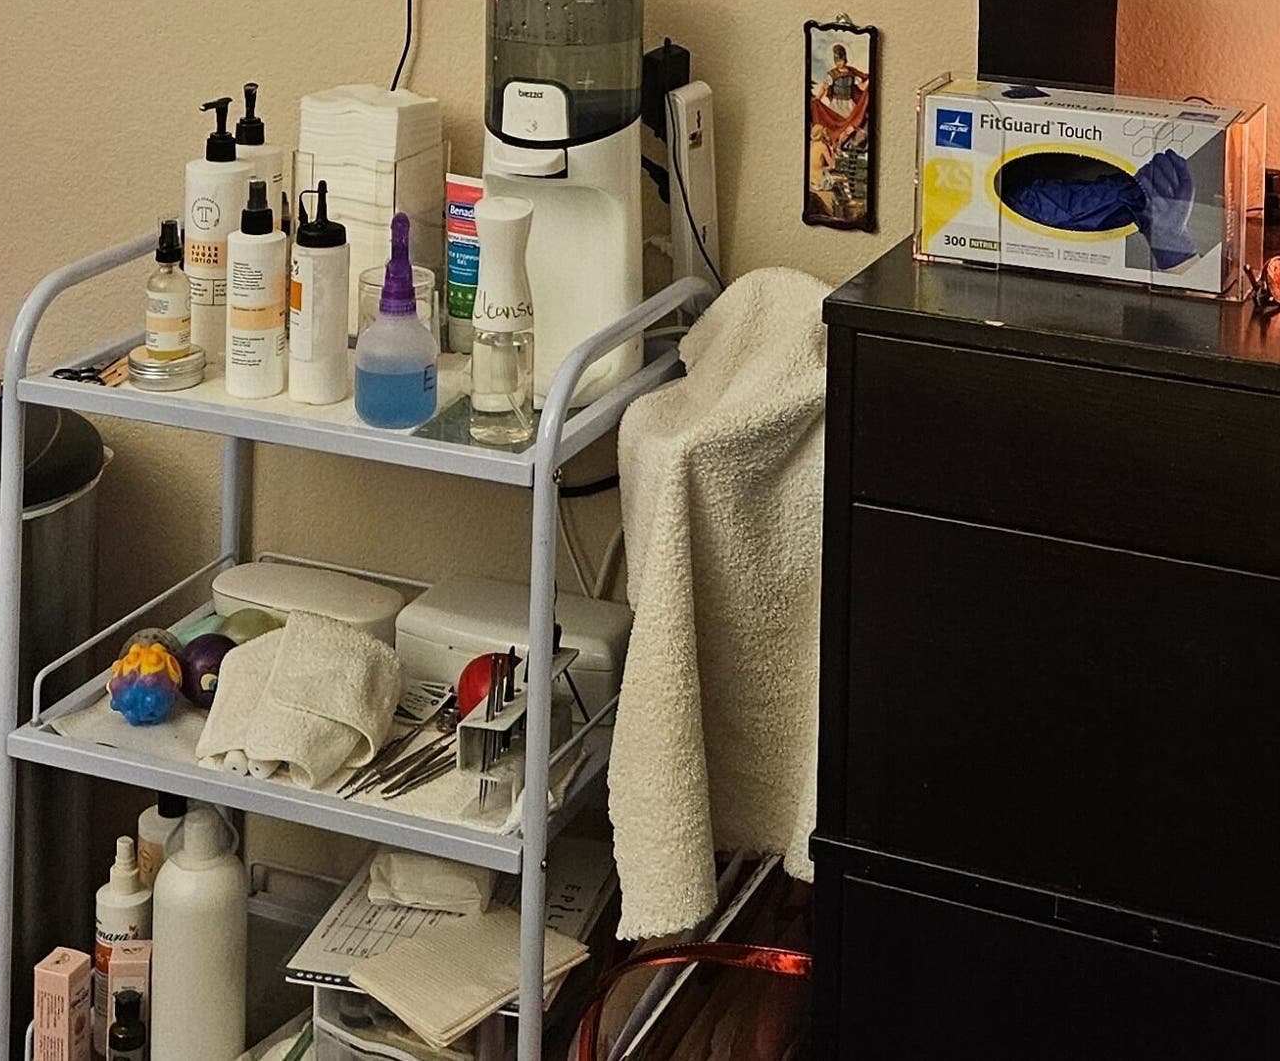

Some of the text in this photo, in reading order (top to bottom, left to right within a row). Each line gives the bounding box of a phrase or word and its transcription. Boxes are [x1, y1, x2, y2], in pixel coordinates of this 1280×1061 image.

[939, 124, 969, 133] MEDLINE
[980, 114, 1102, 141] FitGuard Touch
[450, 205, 475, 218] Benad
[191, 244, 219, 252] AFTER
[943, 235, 1000, 250] 300 NITRILE
